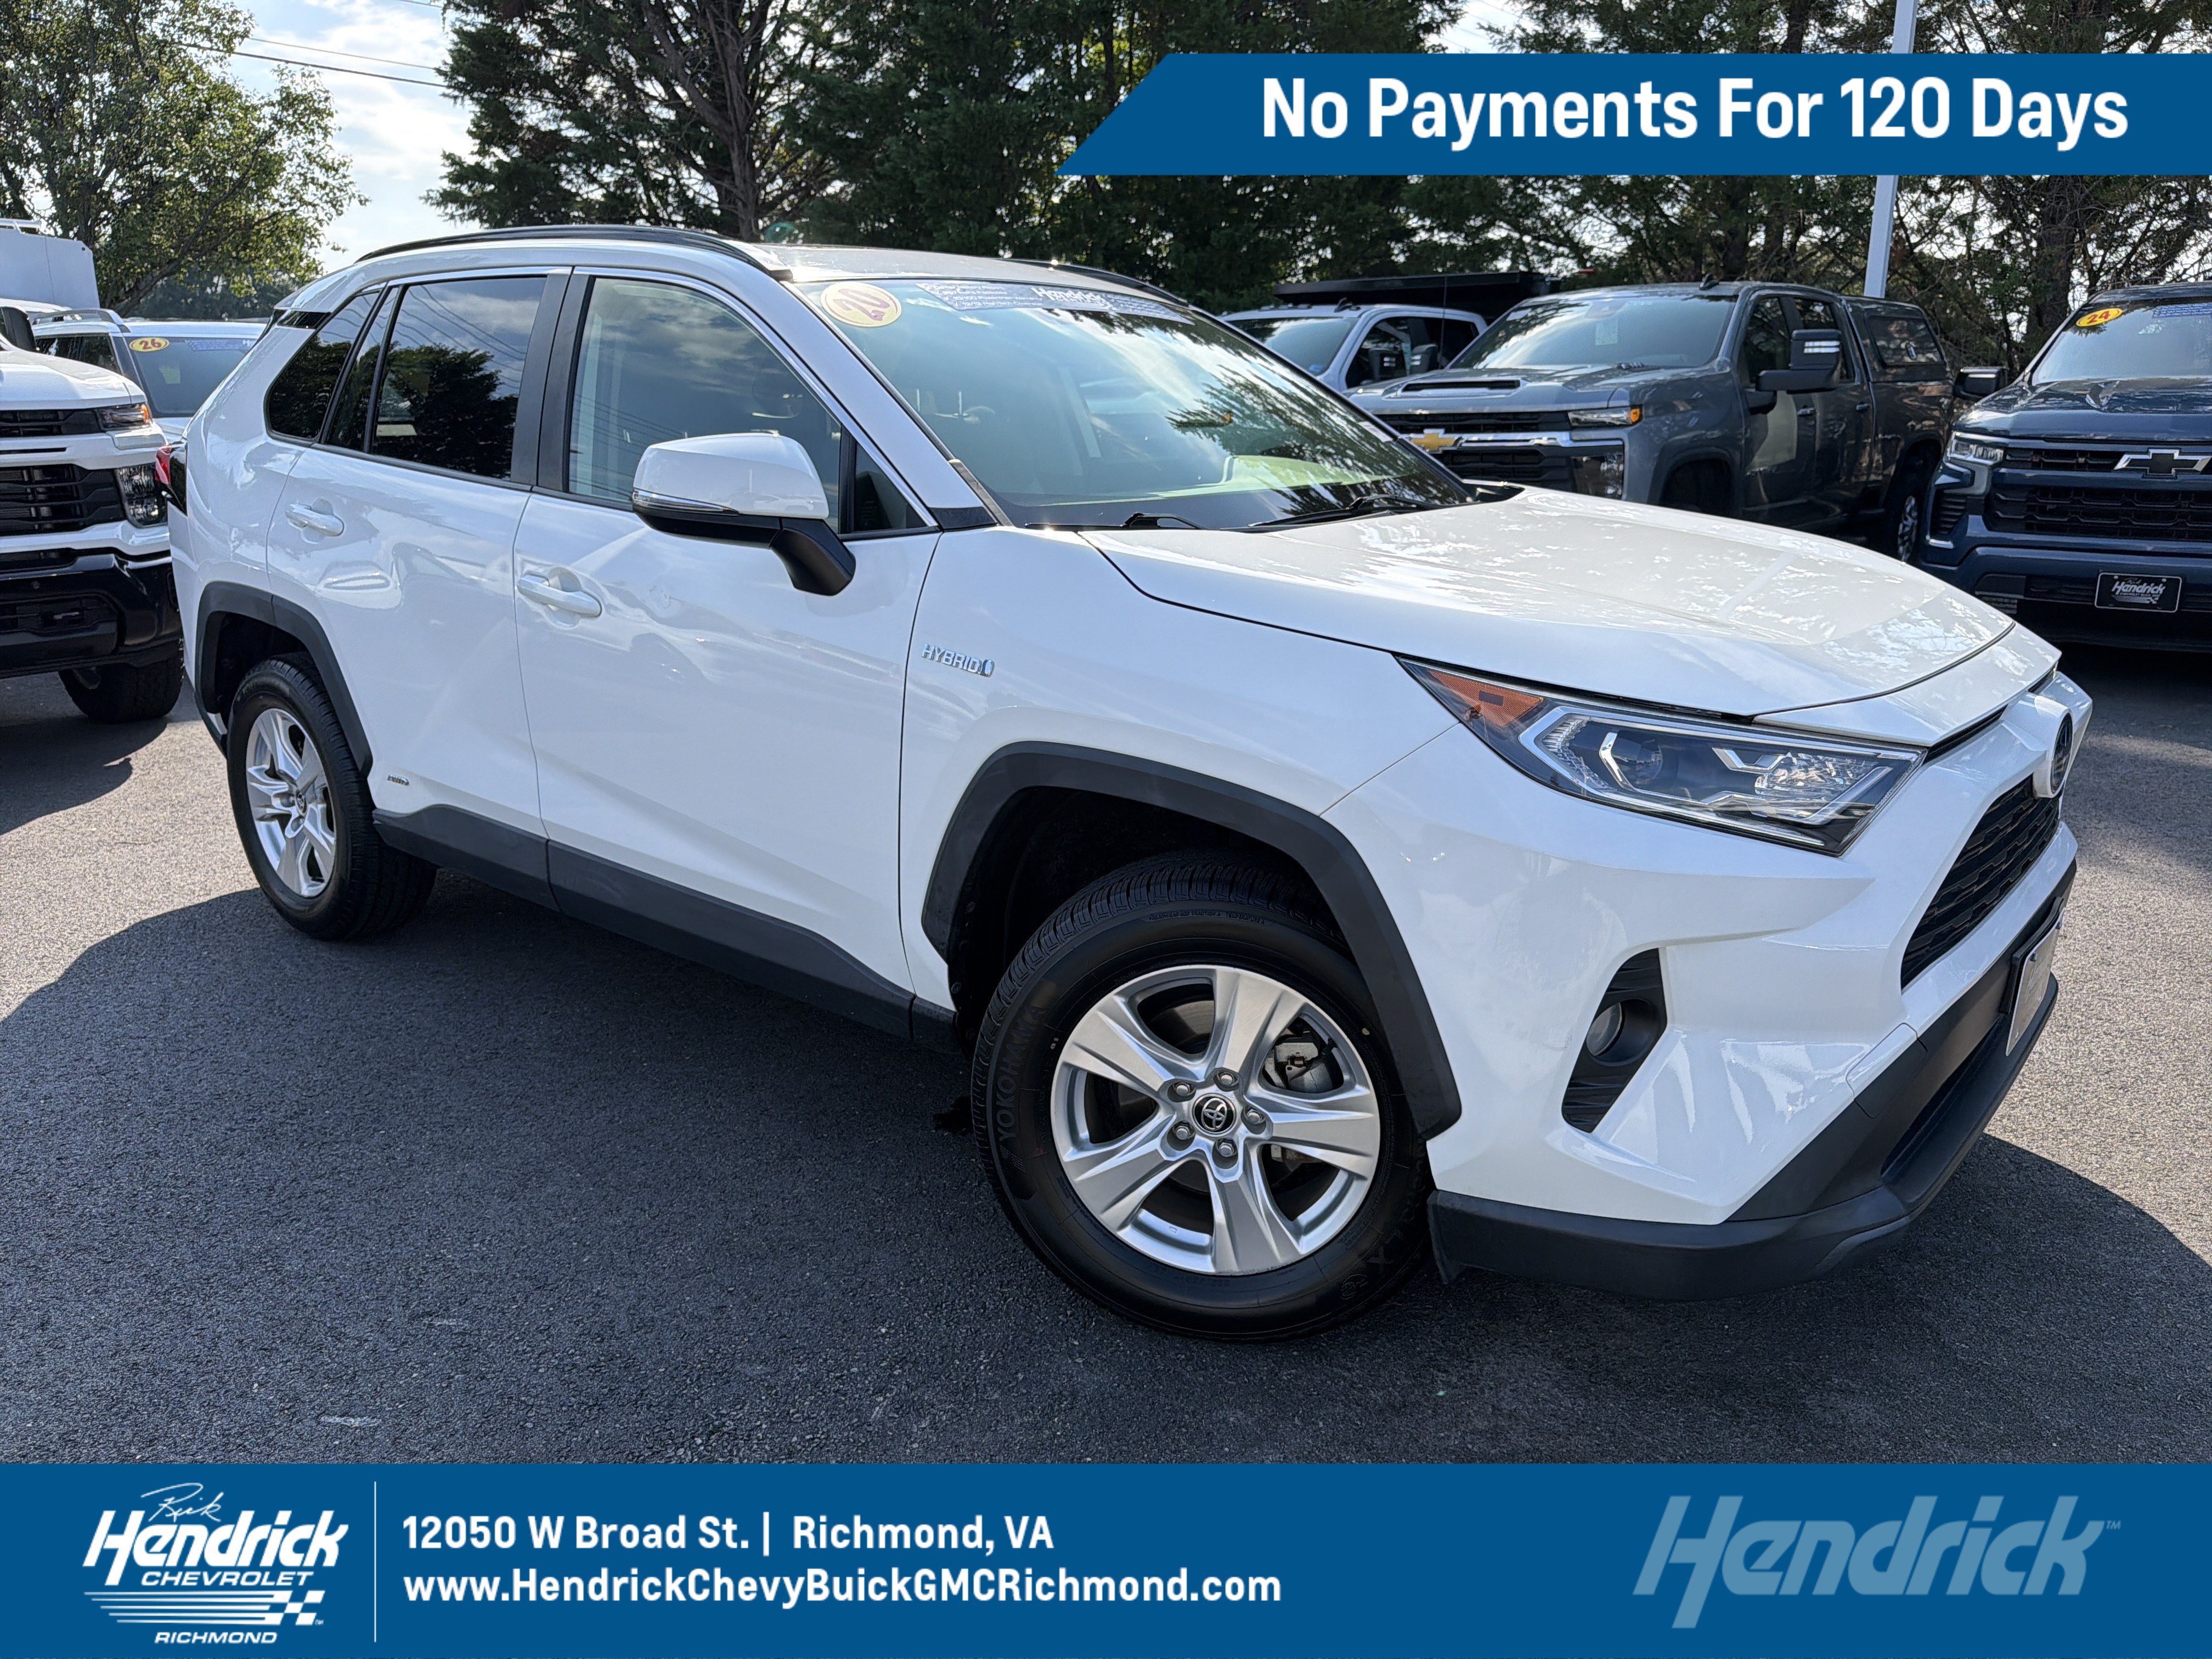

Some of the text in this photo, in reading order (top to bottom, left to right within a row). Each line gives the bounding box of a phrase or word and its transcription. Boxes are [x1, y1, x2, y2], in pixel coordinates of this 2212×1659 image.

[833, 287, 890, 321] 20
[2086, 311, 2111, 324] 24
[139, 338, 161, 350] 26
[2111, 581, 2166, 595] Hendrick
[922, 644, 982, 674] HYBRID
